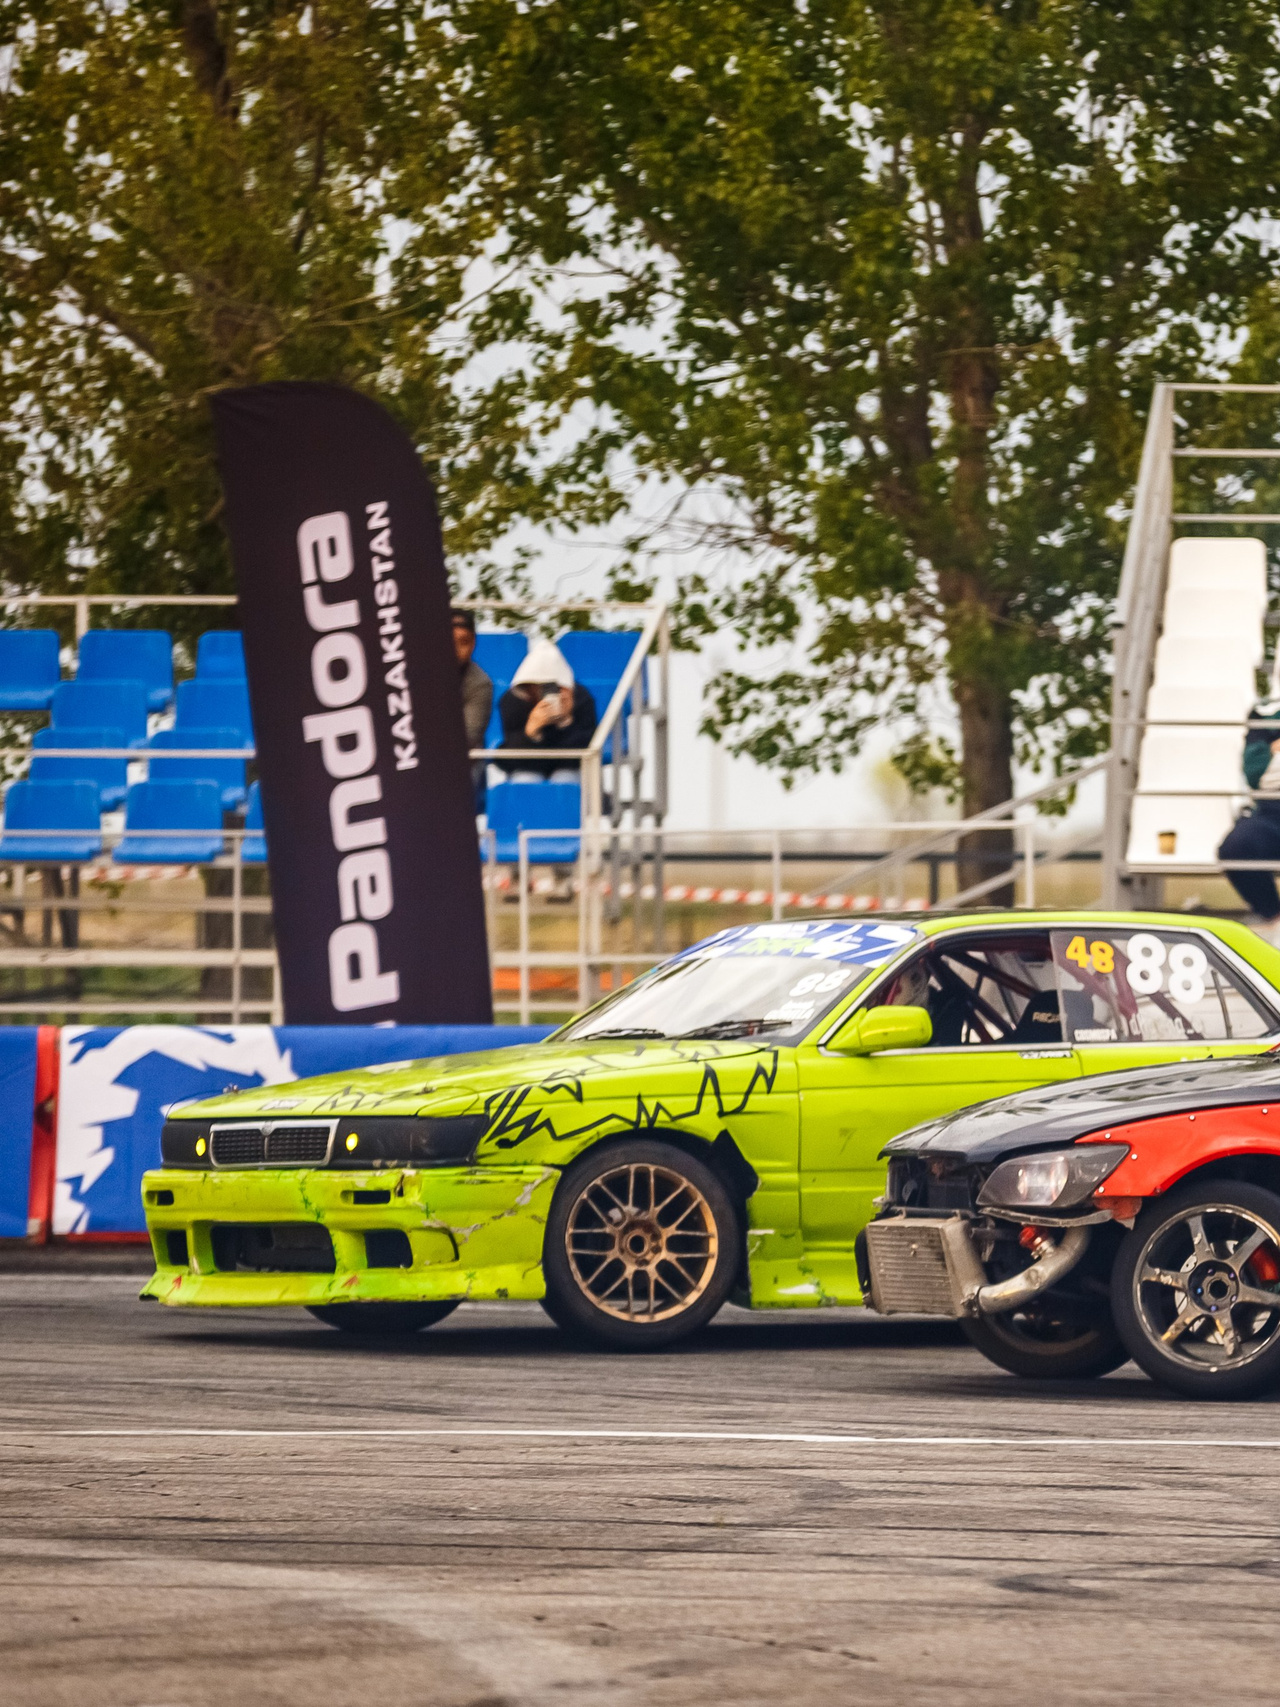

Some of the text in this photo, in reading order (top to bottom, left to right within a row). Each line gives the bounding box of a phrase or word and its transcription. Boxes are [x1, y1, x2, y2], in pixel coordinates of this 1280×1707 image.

[365, 501, 418, 770] KAZAKHSTAN
[1065, 936, 1114, 973] 48
[1126, 933, 1207, 1004] 88
[789, 969, 851, 997] 88
